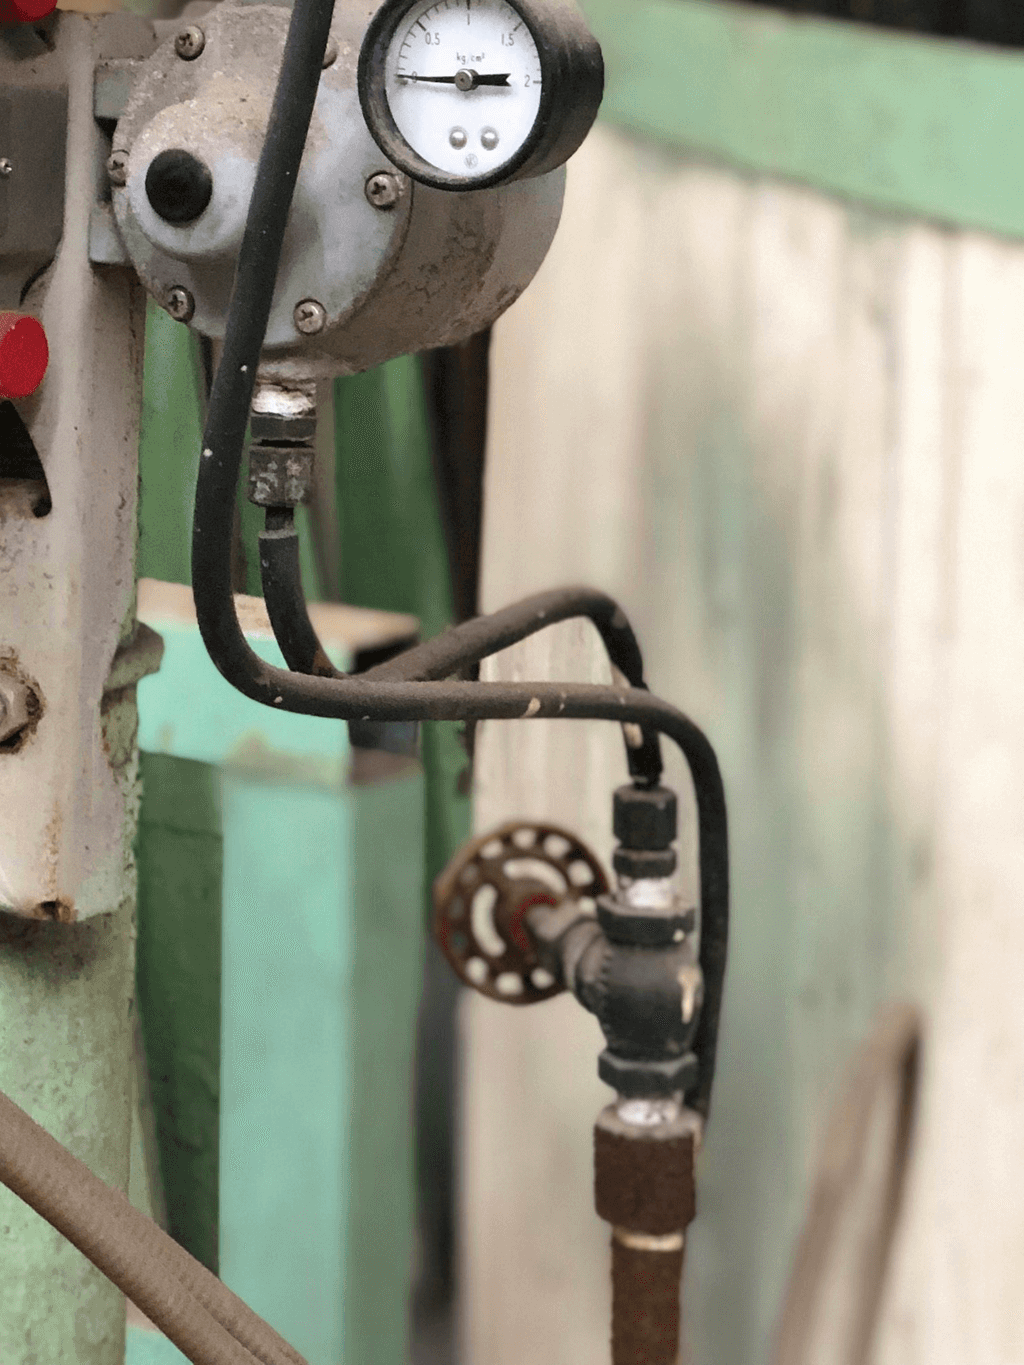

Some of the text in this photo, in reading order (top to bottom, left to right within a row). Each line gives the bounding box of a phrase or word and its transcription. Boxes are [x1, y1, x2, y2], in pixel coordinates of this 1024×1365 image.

[425, 32, 440, 46] 0.5
[501, 33, 515, 47] 1.5
[411, 71, 418, 84] 0
[524, 74, 531, 88] 2
